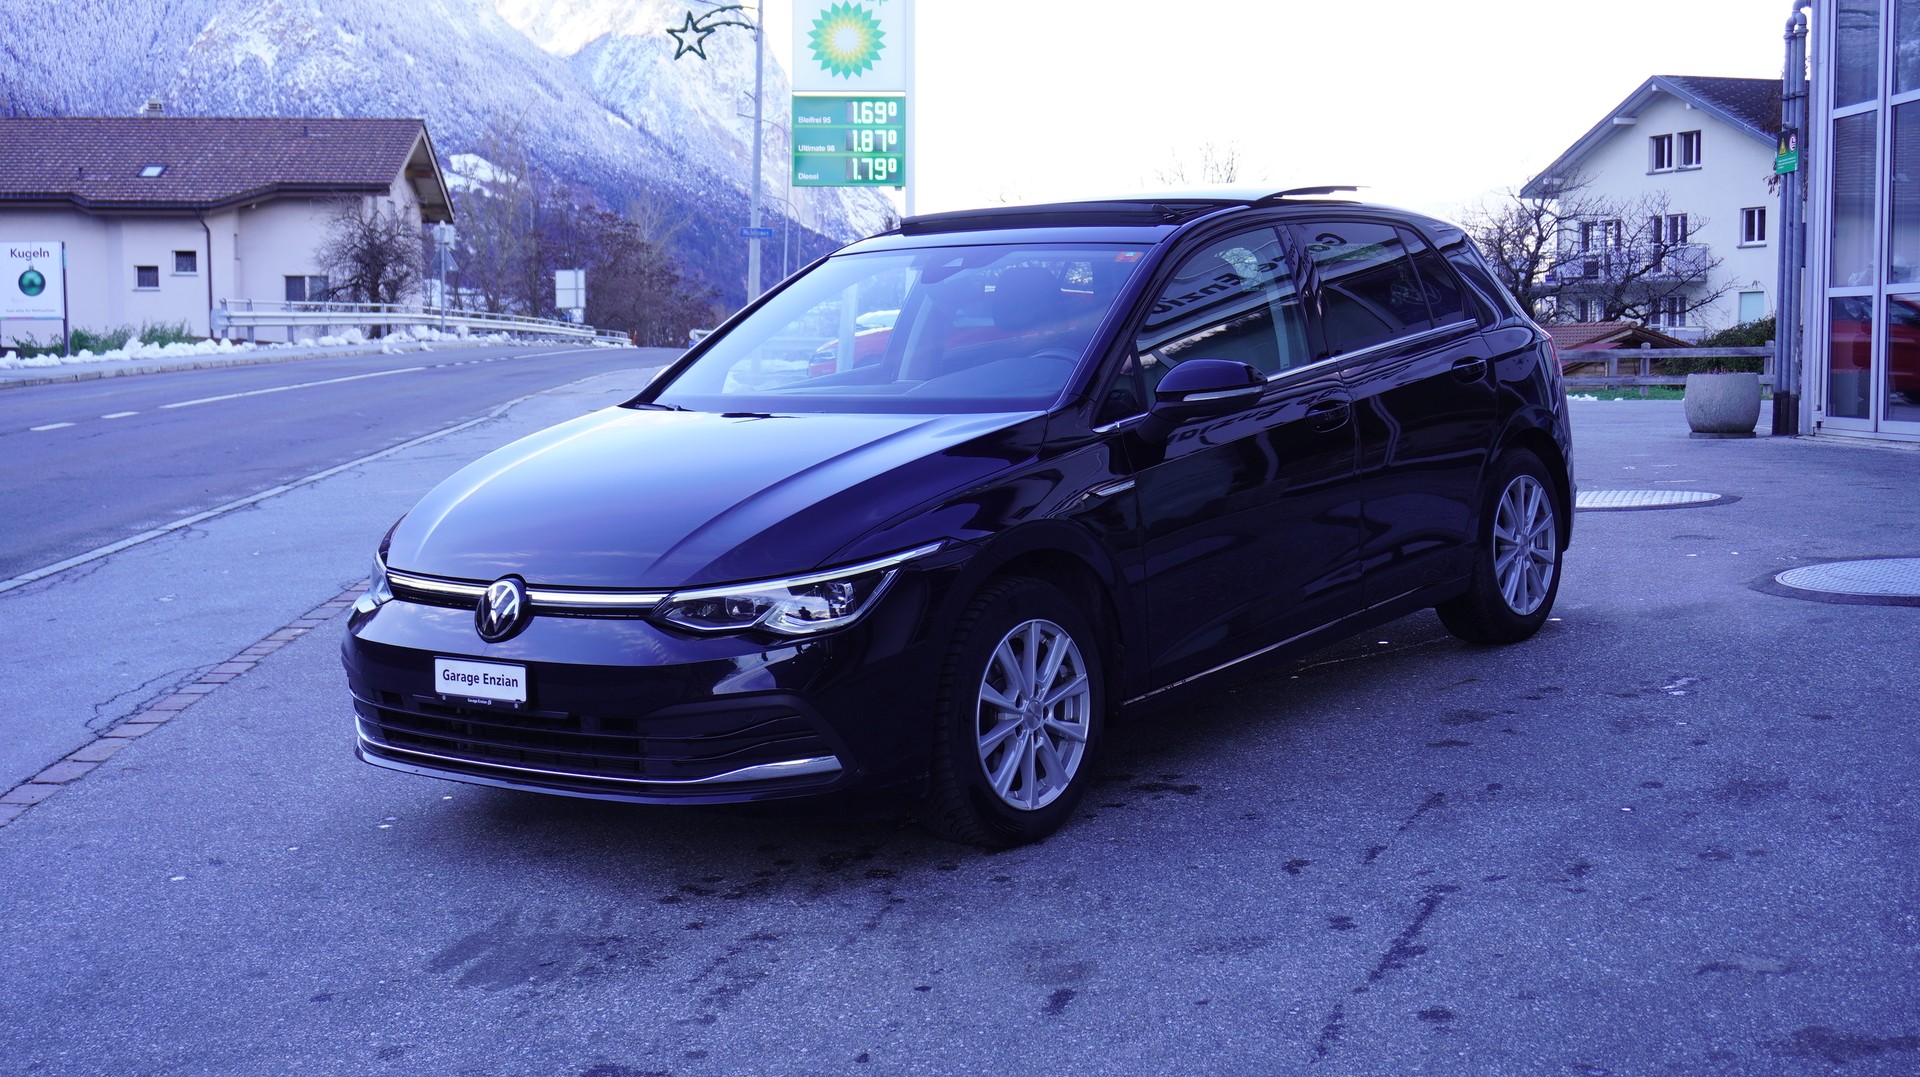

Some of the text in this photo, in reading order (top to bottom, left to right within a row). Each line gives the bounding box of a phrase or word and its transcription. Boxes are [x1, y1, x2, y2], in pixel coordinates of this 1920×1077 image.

[798, 116, 832, 124] Bleifrei 95
[798, 144, 836, 152] Ultimate 98
[798, 172, 820, 180] Diesel
[10, 247, 50, 261] Kugeln
[442, 669, 519, 688] Garage Enzian
